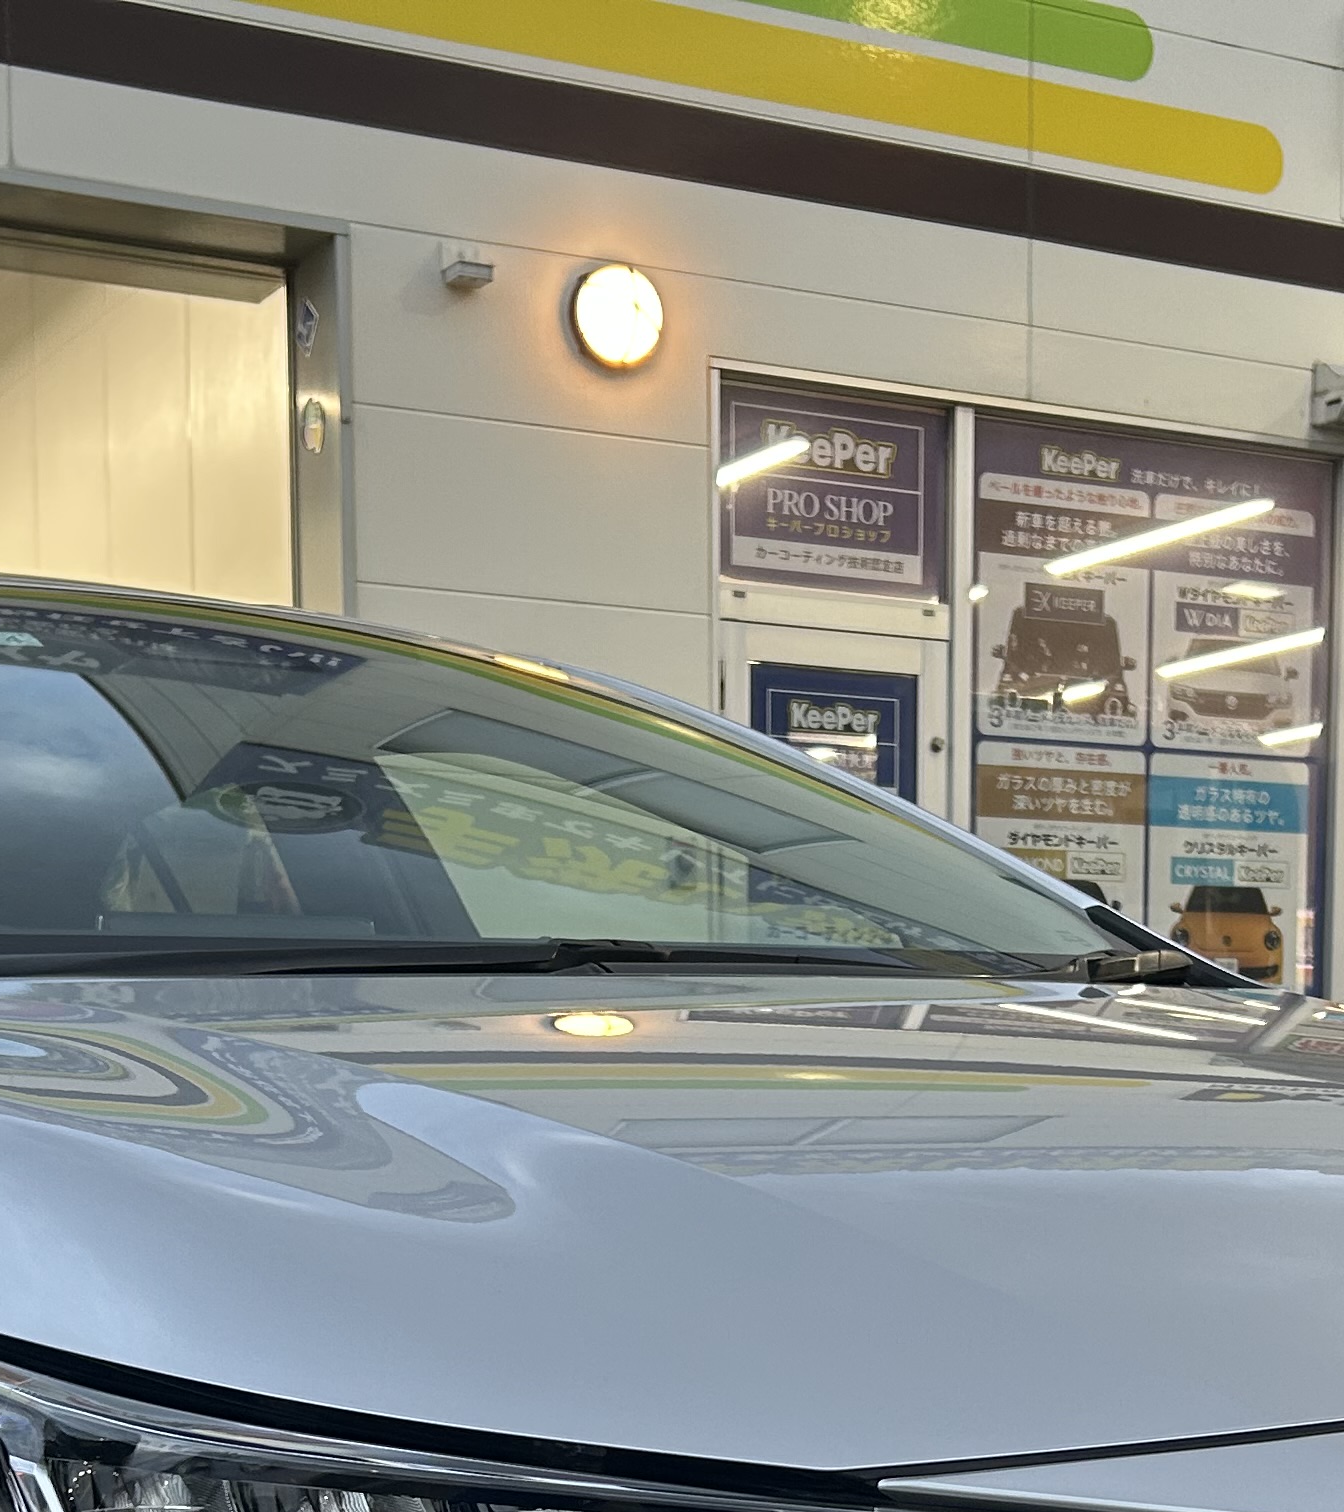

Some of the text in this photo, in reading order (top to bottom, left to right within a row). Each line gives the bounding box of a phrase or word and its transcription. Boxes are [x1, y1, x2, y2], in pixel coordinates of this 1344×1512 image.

[1040, 446, 1120, 481] KeePer
[766, 487, 893, 526] PRO SHOP
[766, 517, 892, 543] キーパープロショップ
[790, 701, 879, 733] KeePer
[1174, 864, 1233, 881] CRYSTAL
